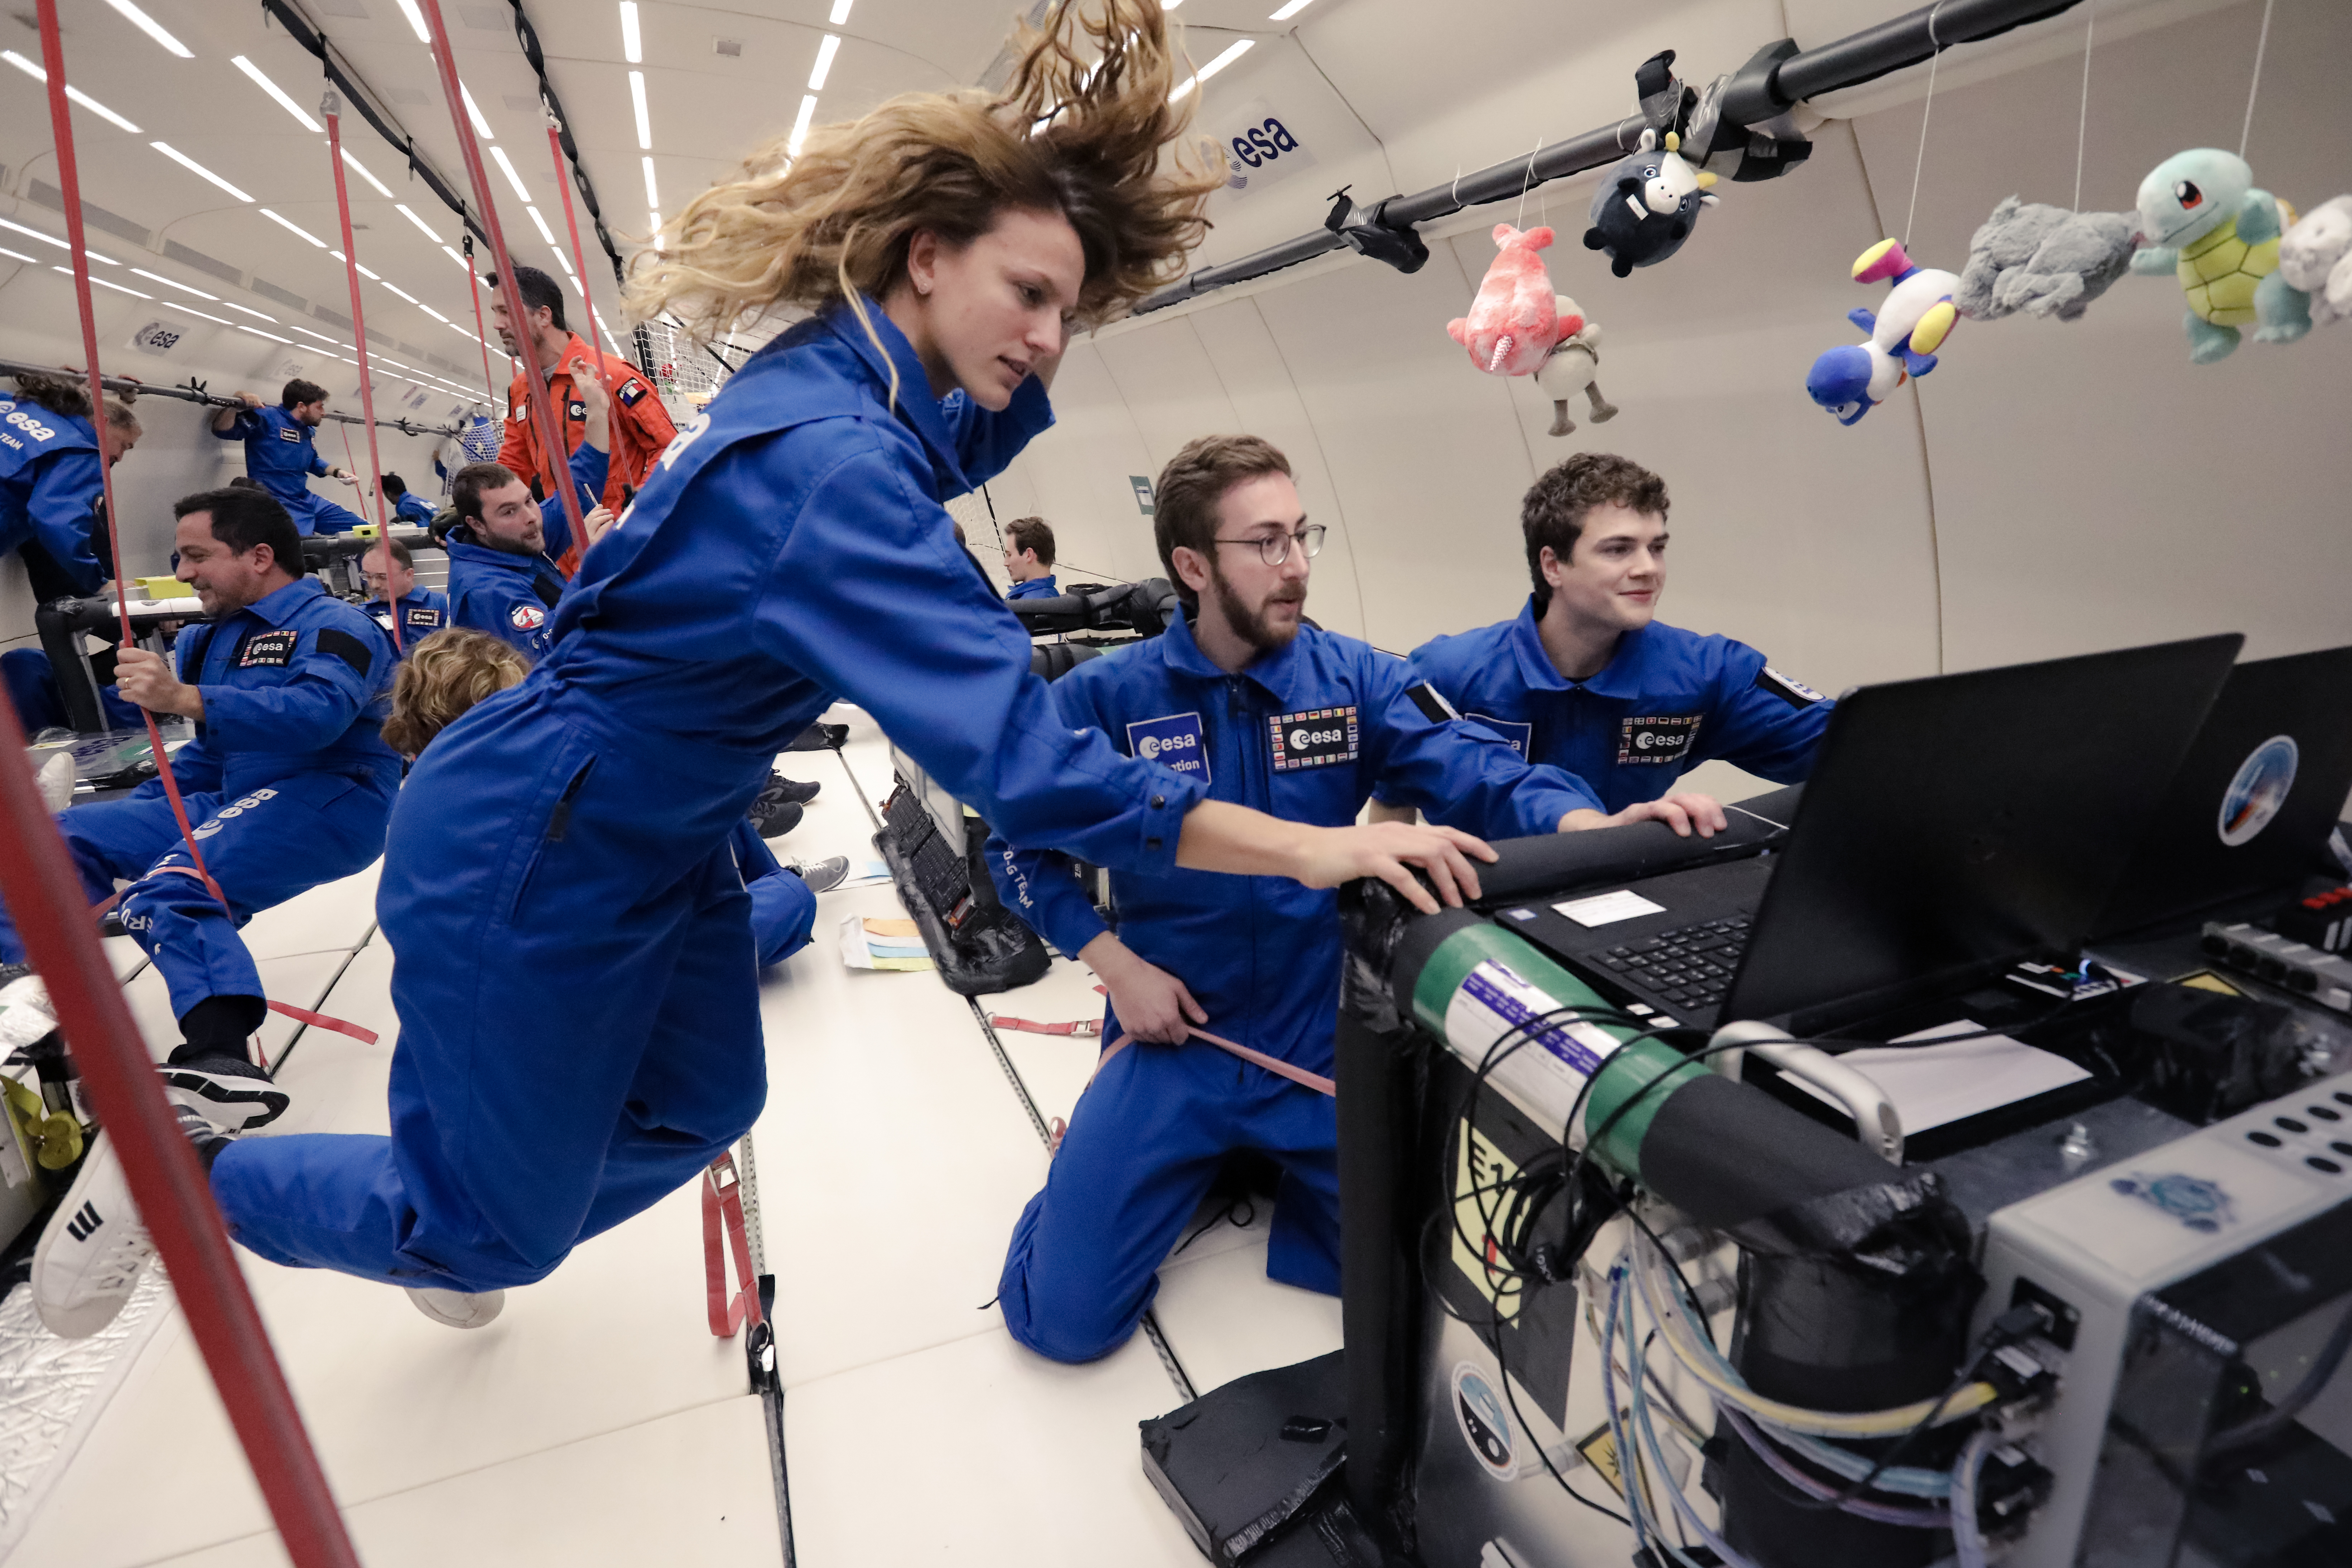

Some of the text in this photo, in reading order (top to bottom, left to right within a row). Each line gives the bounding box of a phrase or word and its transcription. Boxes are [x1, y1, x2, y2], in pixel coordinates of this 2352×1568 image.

[1232, 118, 1299, 167] esa
[620, 380, 633, 394] FRANCE
[0, 433, 24, 450] TEAM
[6, 412, 56, 442] esa
[1014, 873, 1034, 908] TEAM
